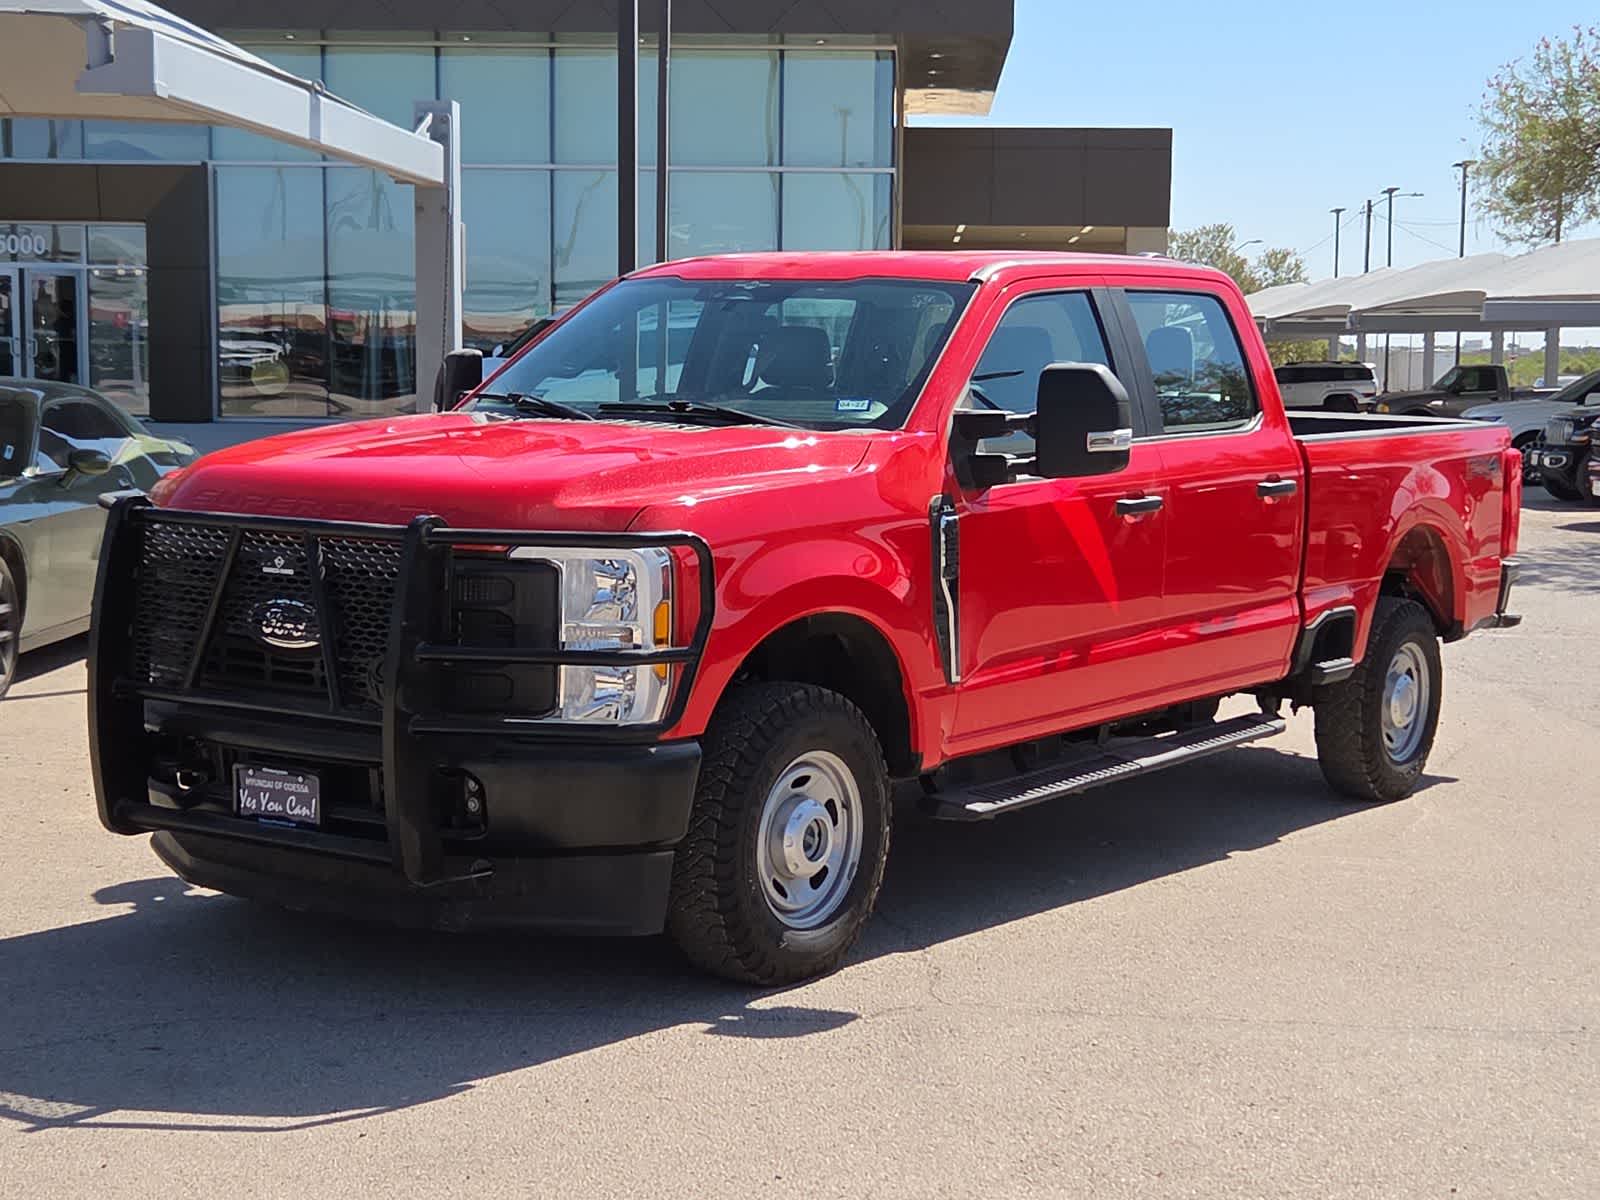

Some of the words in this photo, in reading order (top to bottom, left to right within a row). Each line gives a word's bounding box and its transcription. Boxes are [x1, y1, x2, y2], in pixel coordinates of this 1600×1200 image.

[239, 788, 256, 811] Yes
[260, 791, 284, 812] You
[286, 795, 316, 819] Can!
